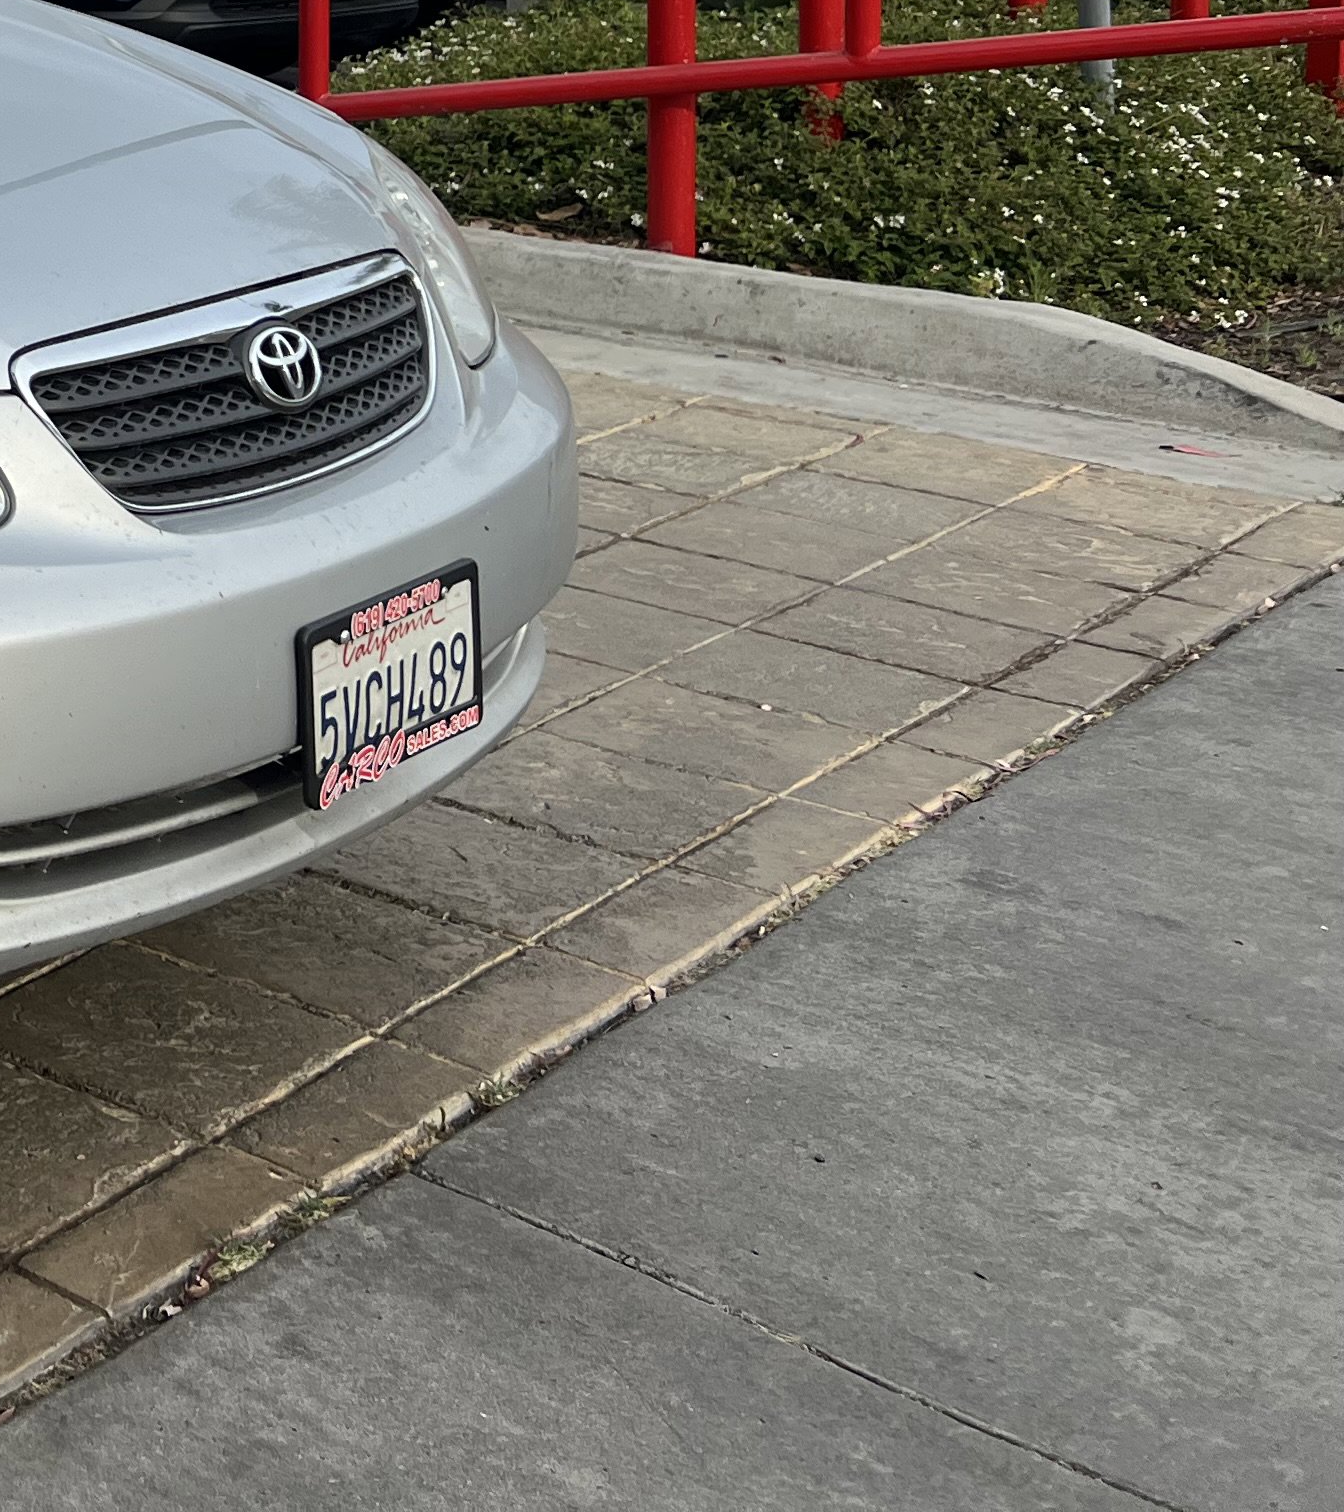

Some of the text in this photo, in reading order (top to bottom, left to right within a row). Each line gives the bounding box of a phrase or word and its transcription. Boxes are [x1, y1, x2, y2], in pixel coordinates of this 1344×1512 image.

[341, 607, 446, 668] California
[350, 578, 441, 638] (619) 420-5700
[320, 632, 468, 767] 5VCH489
[320, 705, 480, 810] CARCO SALES.COM
